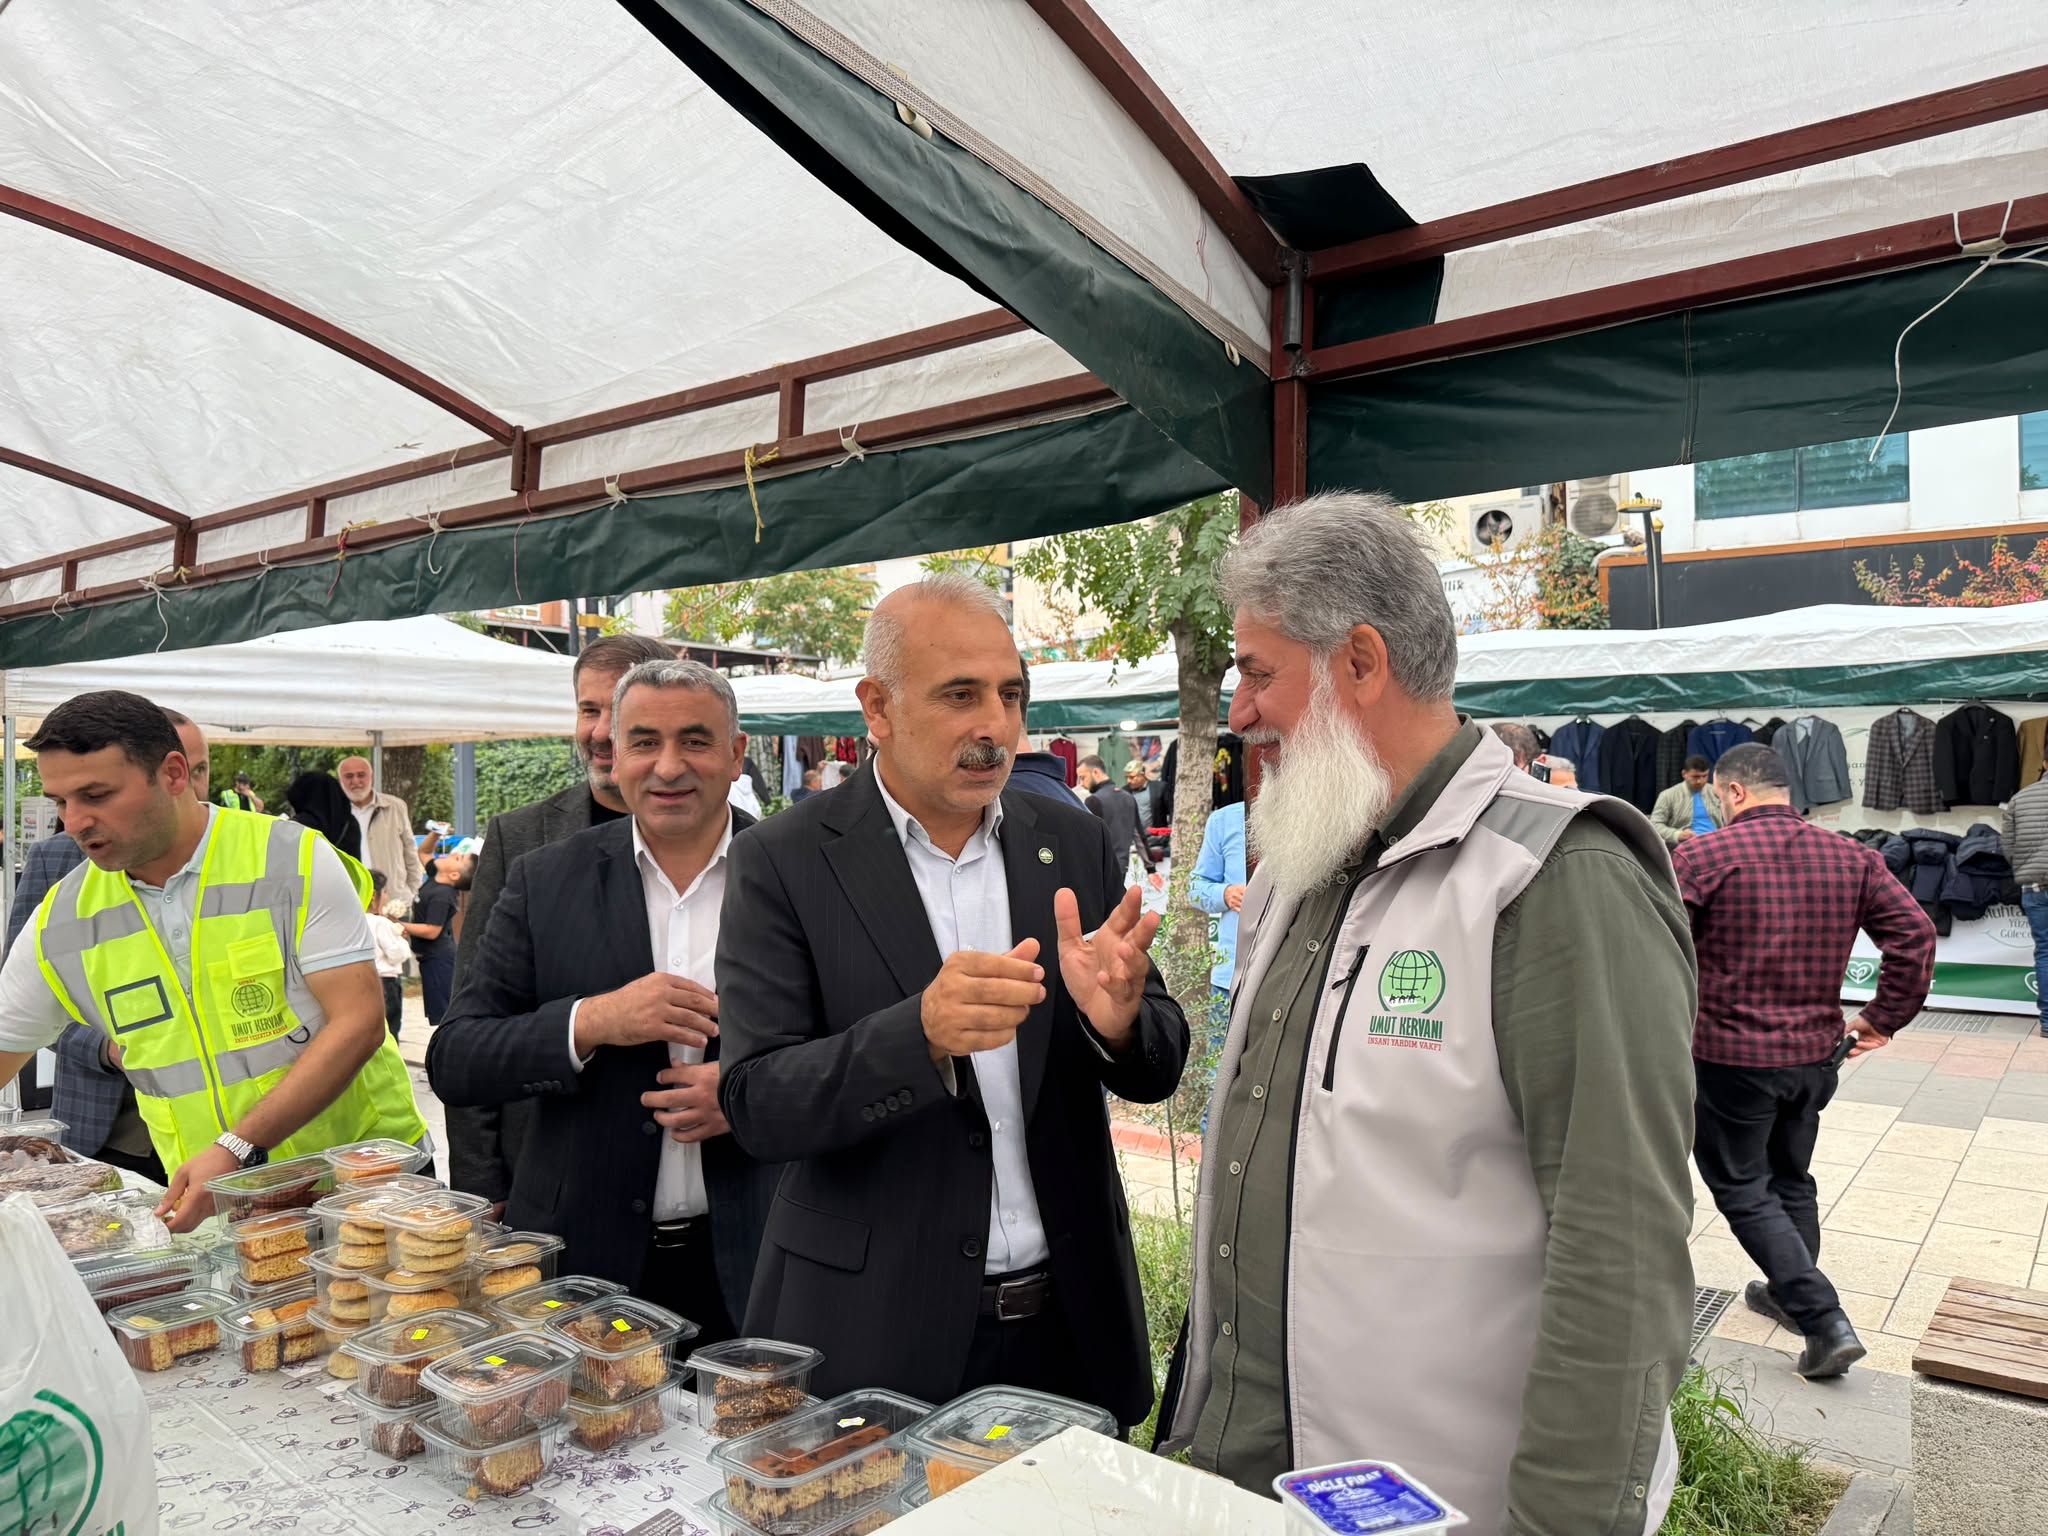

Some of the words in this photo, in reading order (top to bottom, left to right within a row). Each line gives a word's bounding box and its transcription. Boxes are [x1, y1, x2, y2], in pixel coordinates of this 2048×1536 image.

[231, 1021, 253, 1037] UMUT
[1369, 1015, 1398, 1034] UMUT
[1399, 1017, 1443, 1040] KERVANI
[1391, 1038, 1418, 1049] YARDIM
